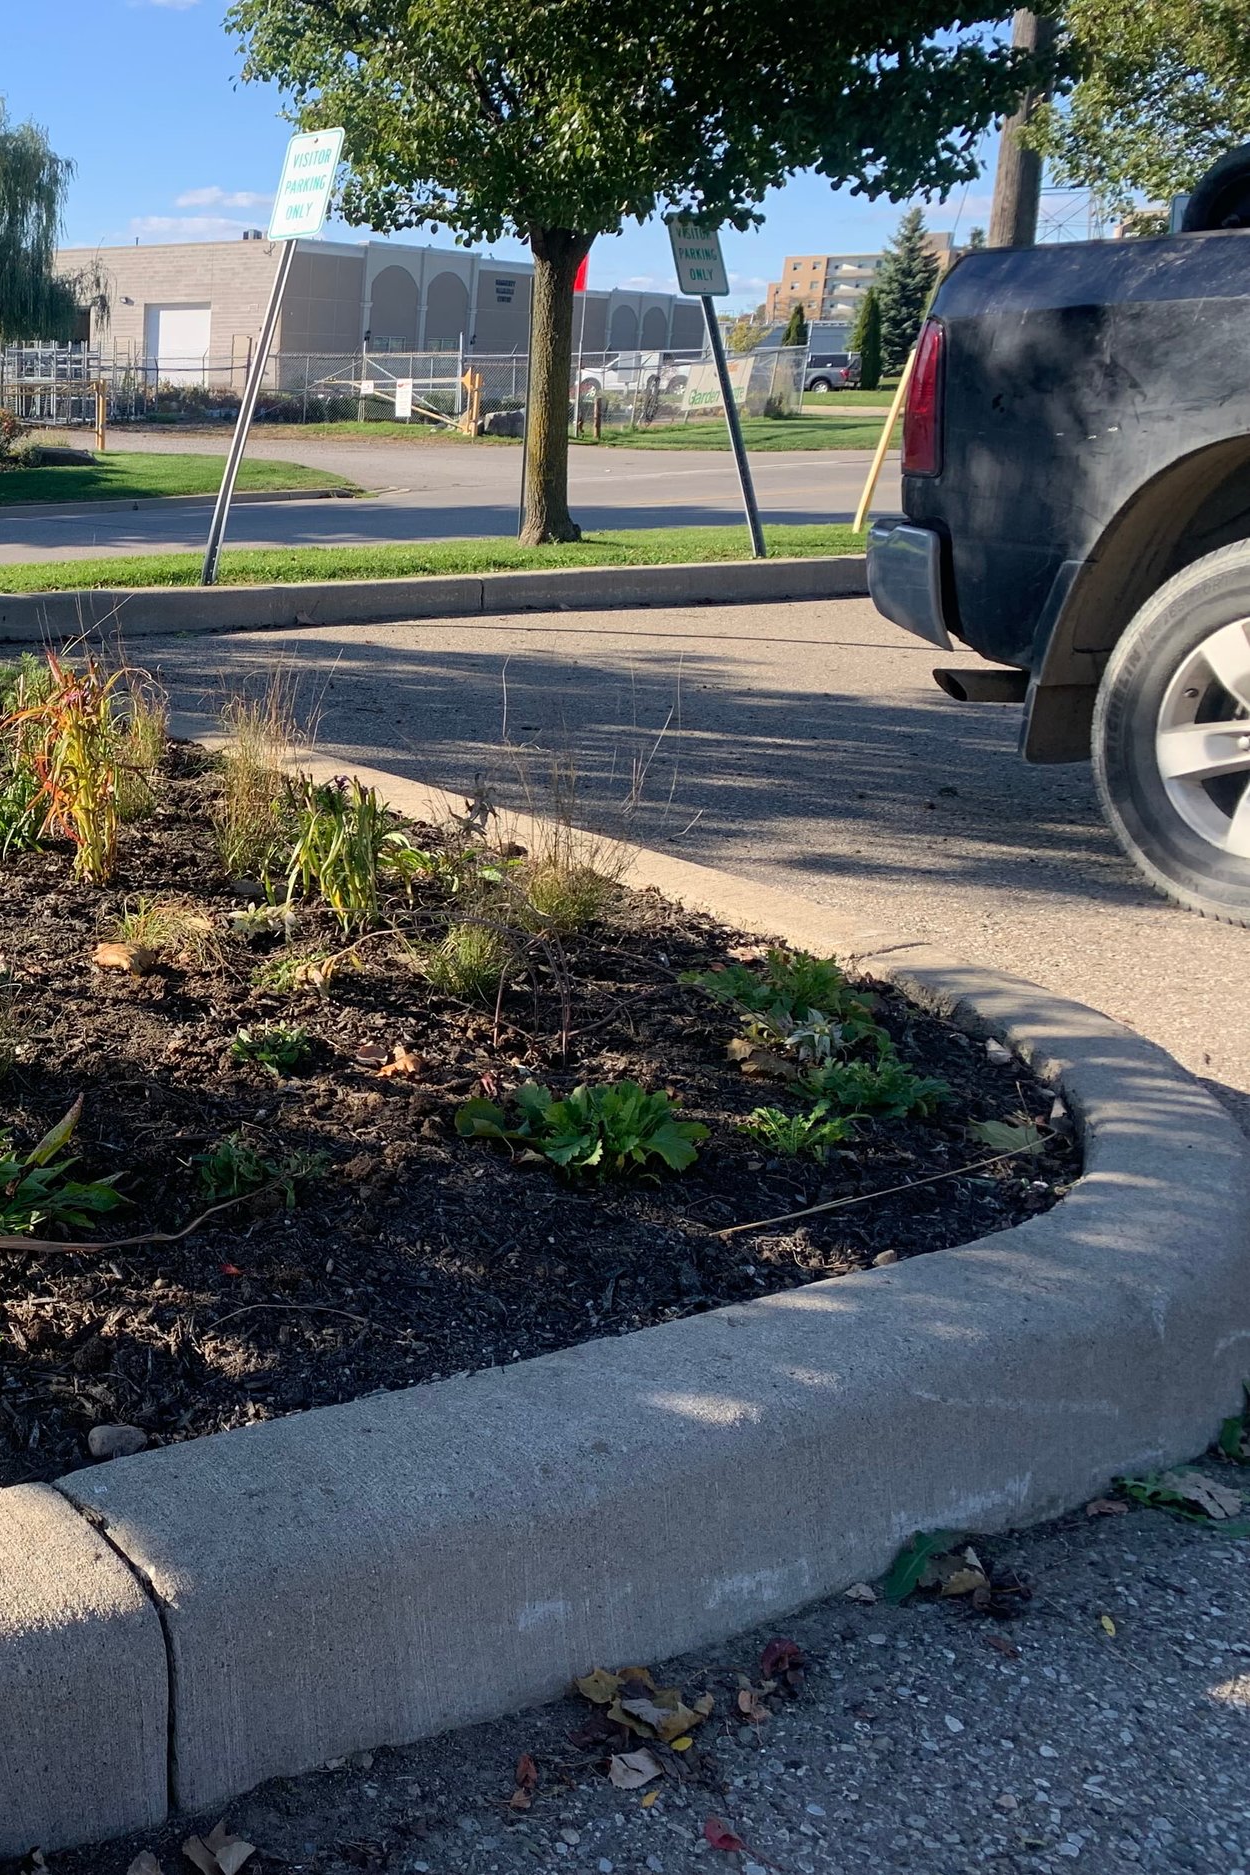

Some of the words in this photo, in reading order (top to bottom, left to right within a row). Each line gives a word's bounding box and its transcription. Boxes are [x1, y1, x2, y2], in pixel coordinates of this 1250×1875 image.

[293, 149, 332, 168] VISITOR
[285, 174, 327, 195] PARKING
[285, 202, 313, 221] ONLY
[678, 247, 717, 260] PARKING
[690, 267, 713, 281] ONLY
[689, 387, 720, 405] Garden
